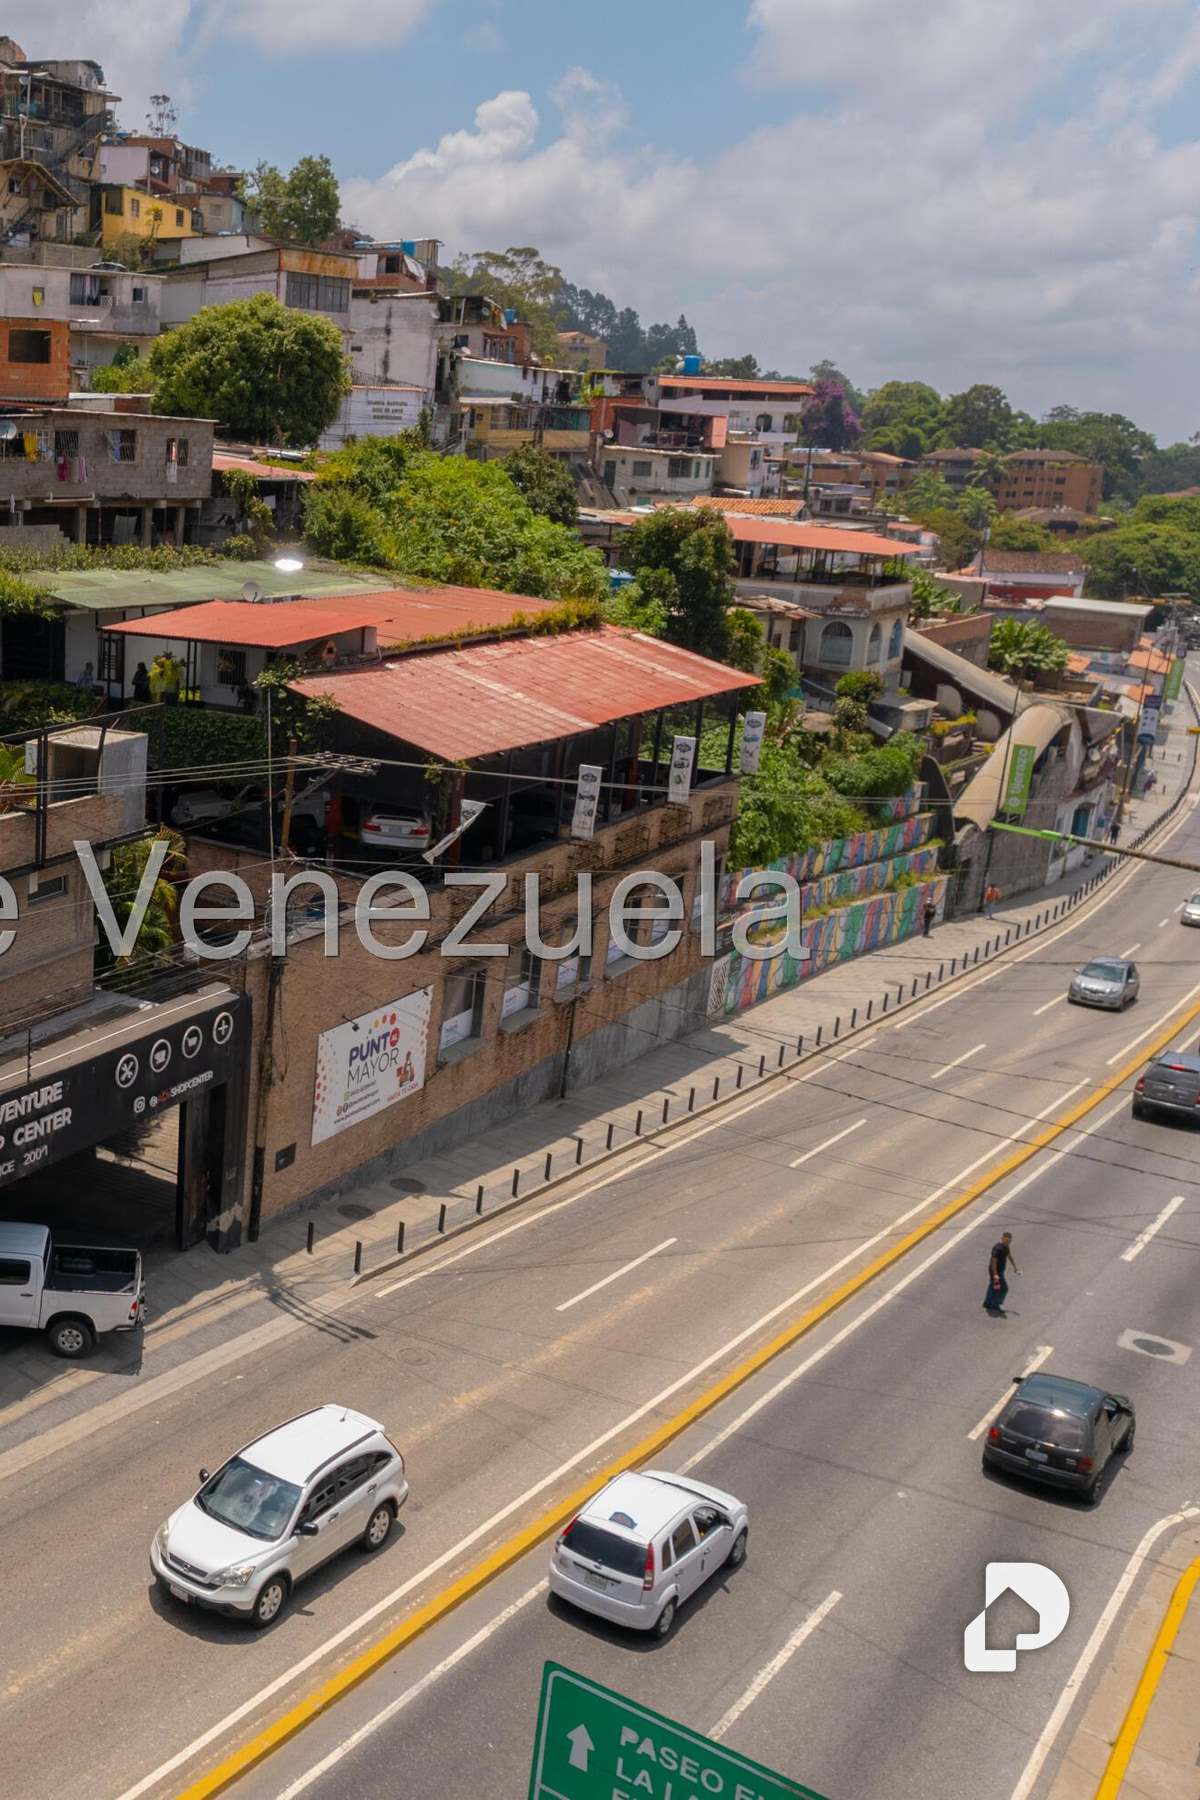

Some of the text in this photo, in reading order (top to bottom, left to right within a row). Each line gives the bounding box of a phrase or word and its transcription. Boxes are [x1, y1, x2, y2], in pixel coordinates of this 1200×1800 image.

[347, 1047, 399, 1089] MAYOR
[12, 1107, 72, 1146] CENTER
[616, 1757, 654, 1795] LA
[620, 1725, 724, 1793] PASEO
